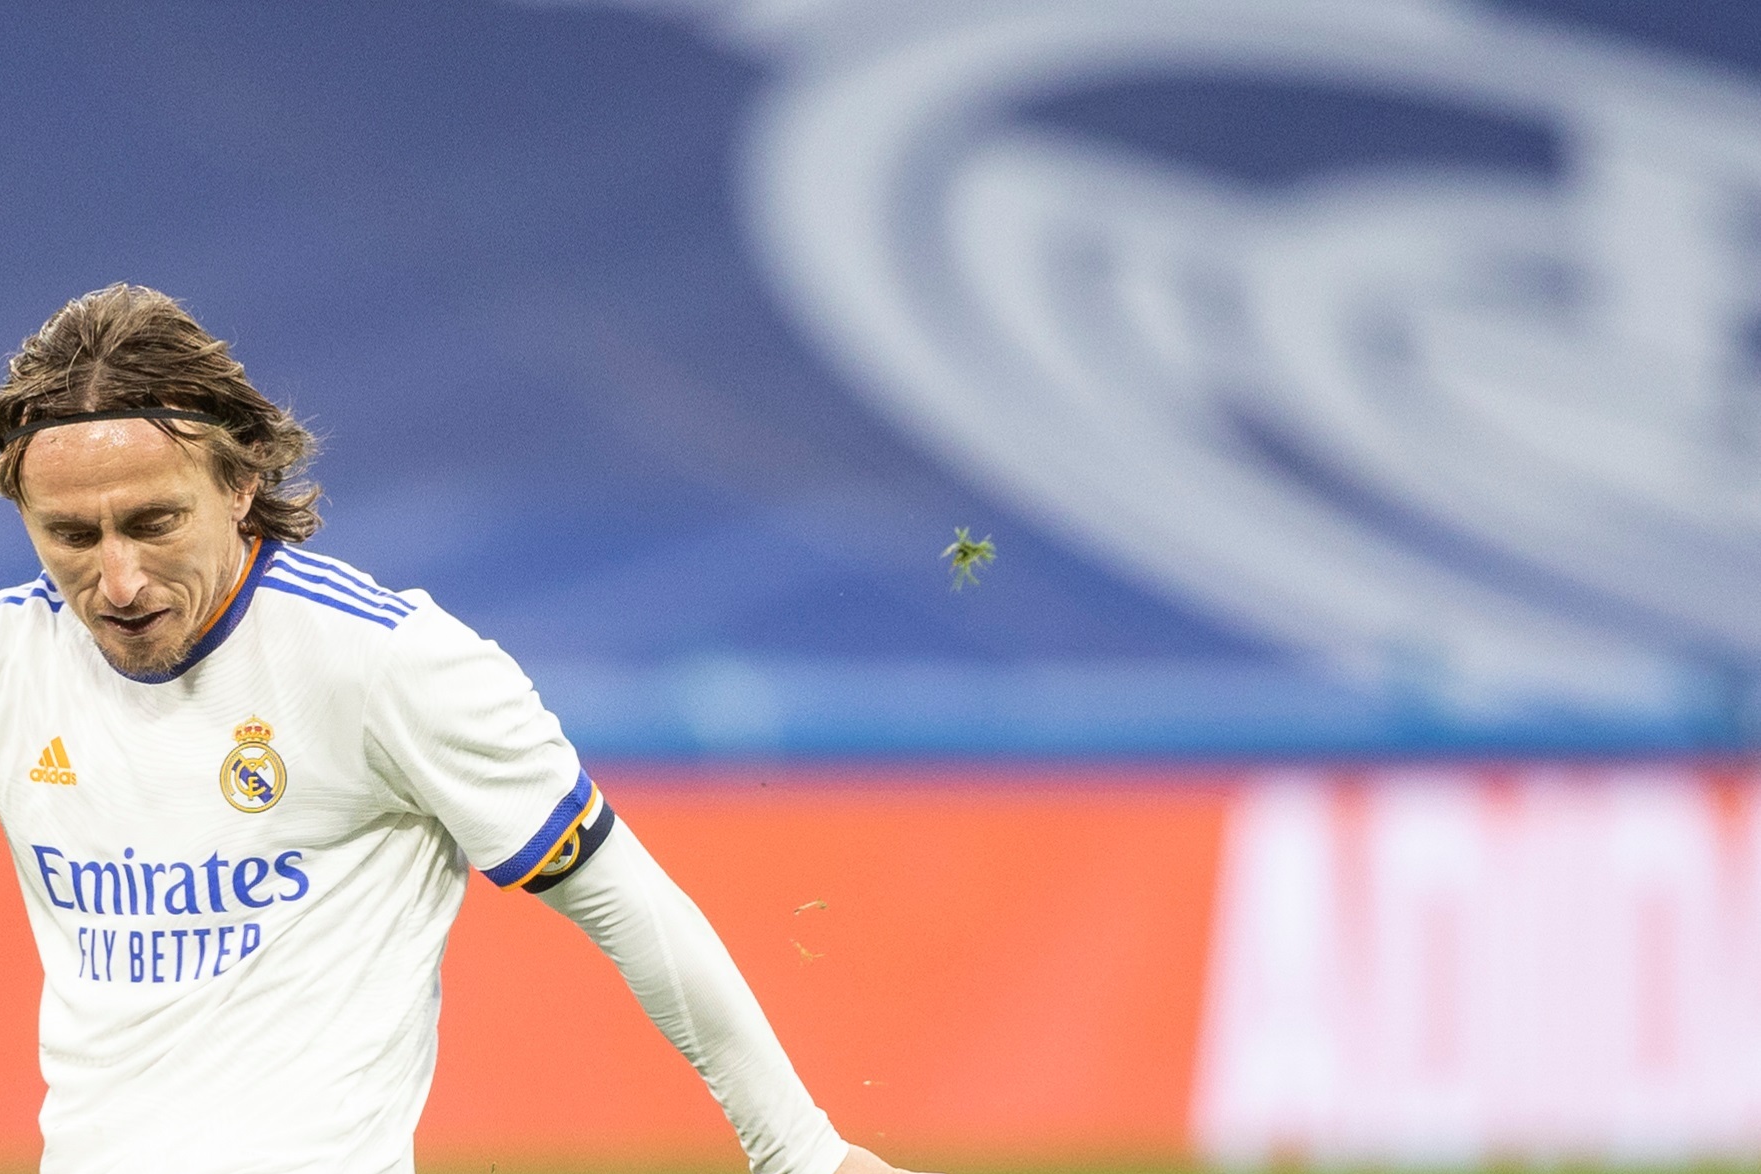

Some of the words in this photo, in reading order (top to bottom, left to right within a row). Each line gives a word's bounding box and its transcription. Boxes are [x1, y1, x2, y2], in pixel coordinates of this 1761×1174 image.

[29, 766, 77, 786] adidas
[31, 844, 309, 915] Emirates
[78, 926, 117, 983] FLY
